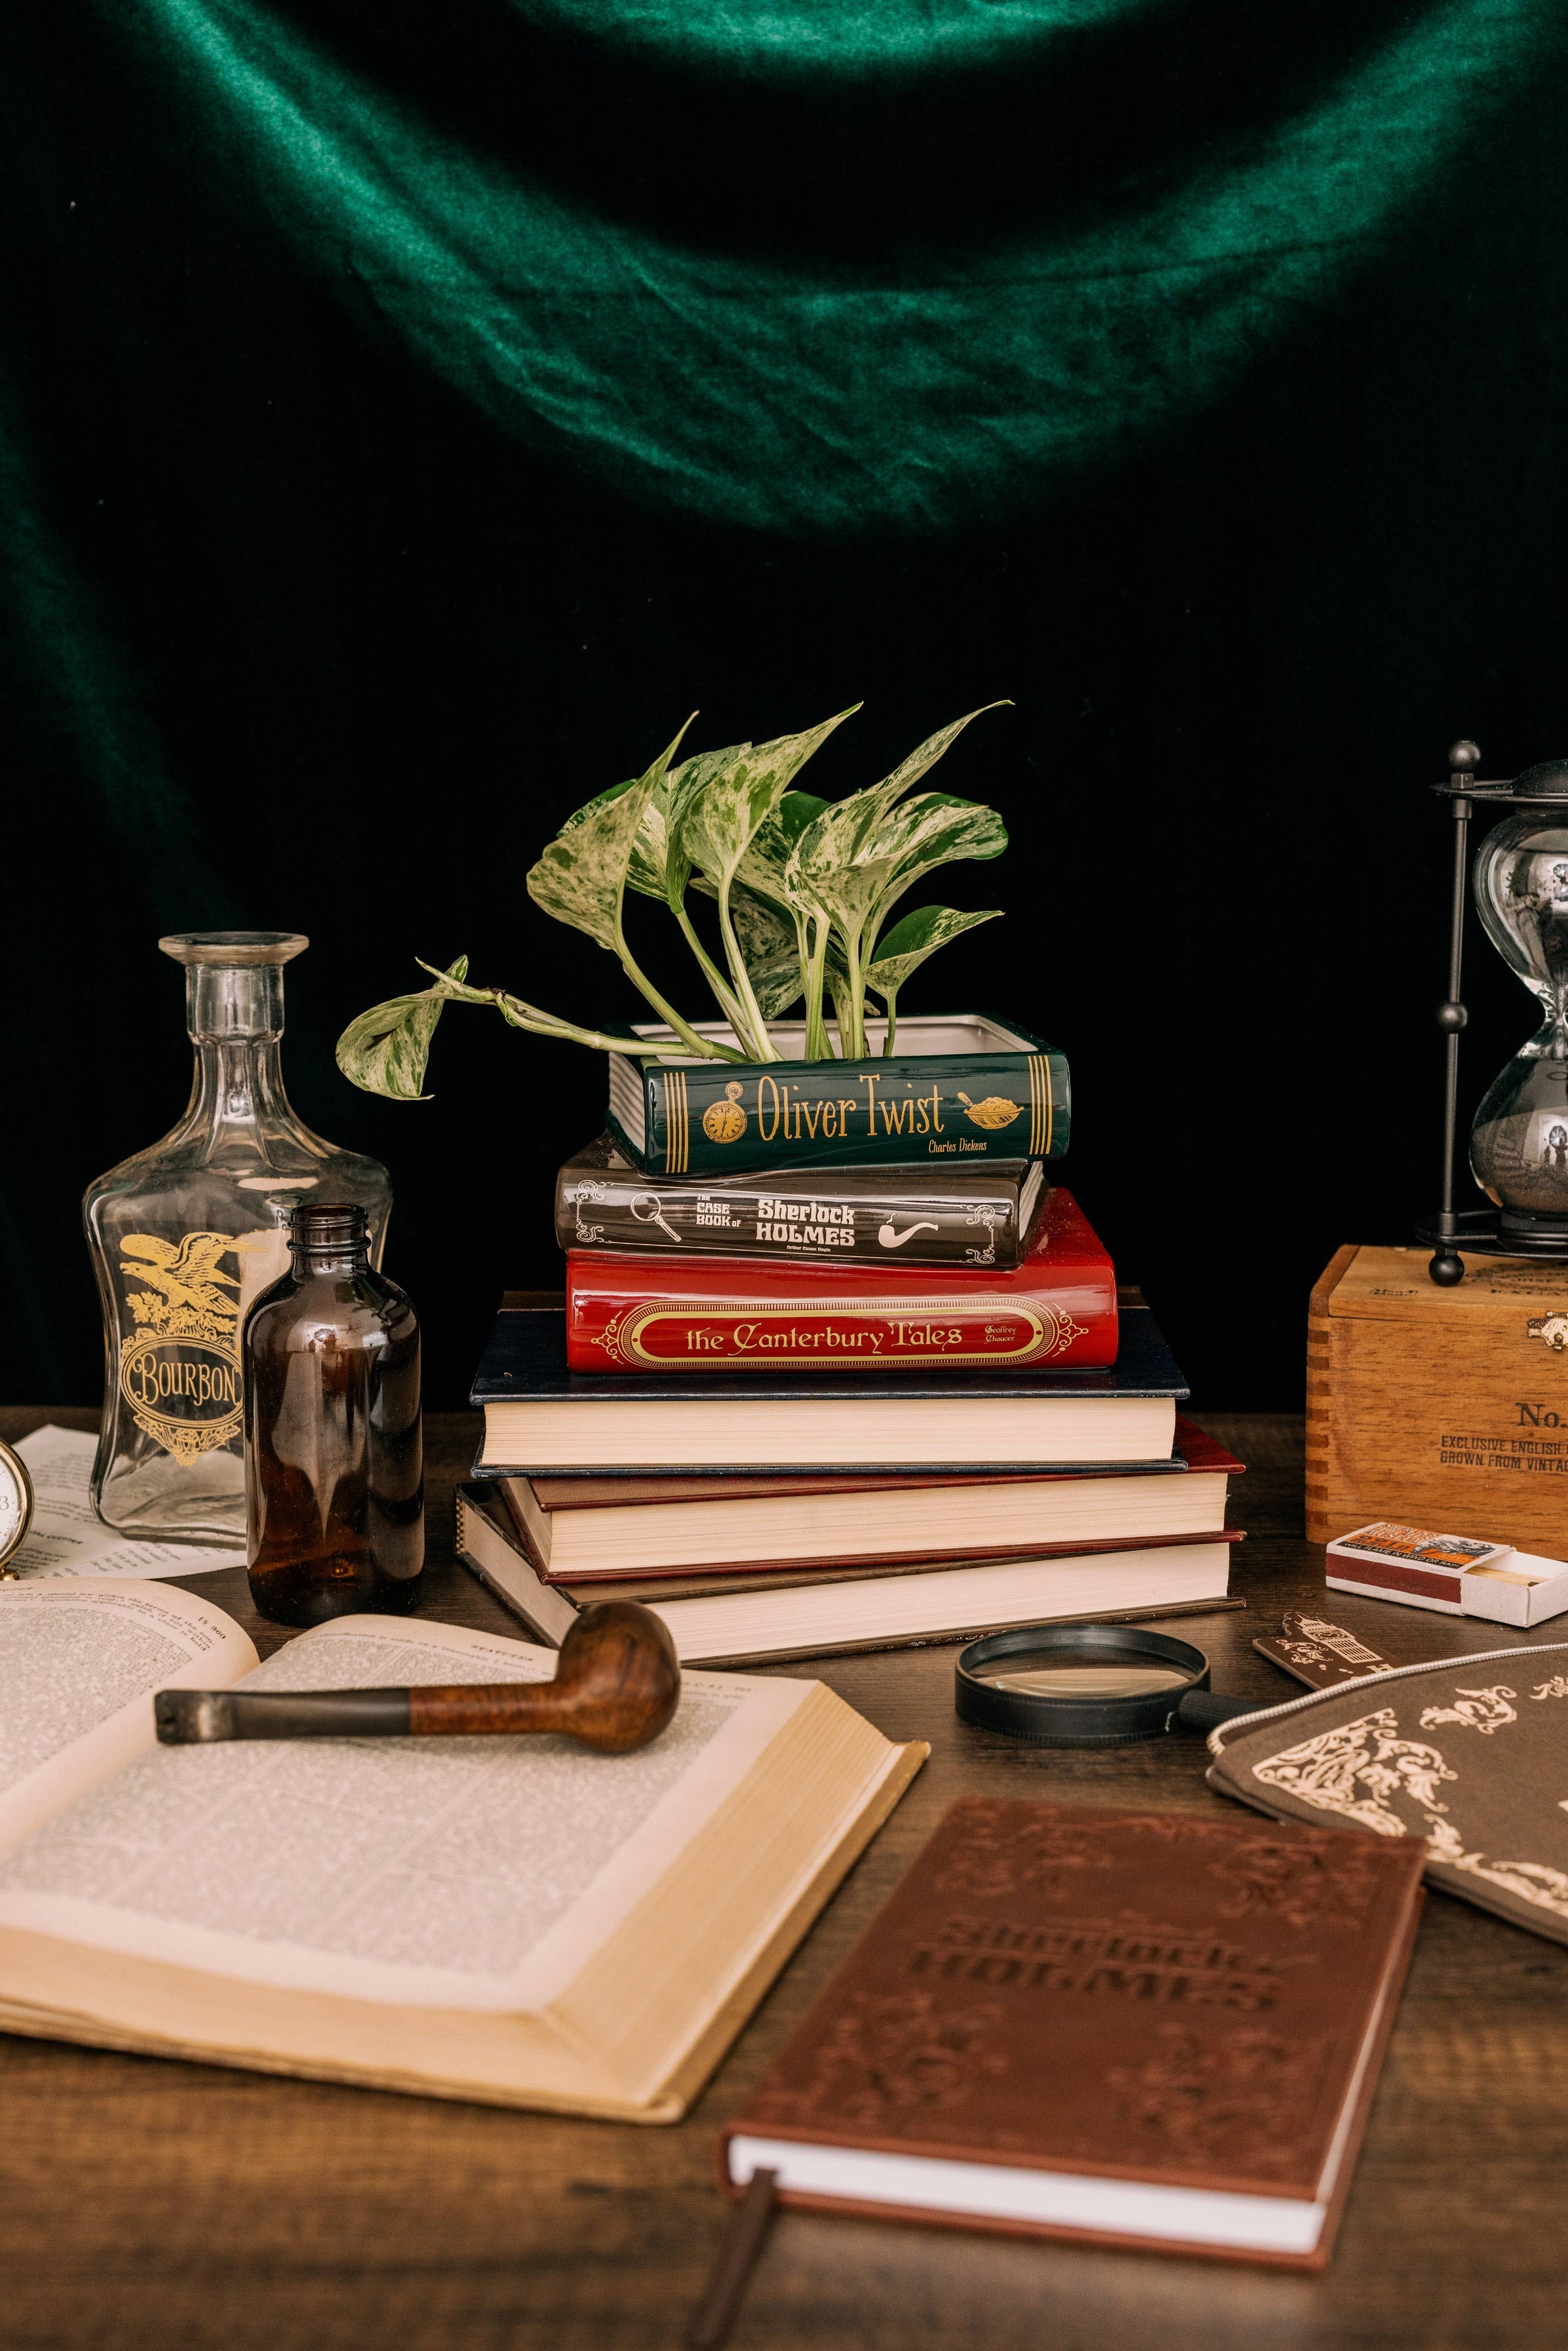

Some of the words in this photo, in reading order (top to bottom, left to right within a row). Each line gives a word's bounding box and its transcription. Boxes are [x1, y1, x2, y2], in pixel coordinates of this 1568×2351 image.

[758, 1076, 857, 1142] Oliver
[859, 1074, 944, 1136] Twist
[928, 1139, 956, 1153] Charles
[958, 1138, 987, 1152] Dickens
[696, 1202, 730, 1215] CASE
[757, 1199, 855, 1226] Sherlock
[696, 1214, 731, 1227] BOOK
[756, 1221, 855, 1247] HOLMES
[685, 1326, 725, 1351] the
[727, 1323, 885, 1356] Canterbury
[887, 1322, 963, 1352] Tales
[985, 1325, 1017, 1335] Geoffrey
[983, 1334, 1015, 1345] Chaucer
[1515, 1402, 1567, 1428] No.
[1441, 1436, 1507, 1452] EXCLUSIVE
[1511, 1440, 1560, 1455] ENGLISH
[1439, 1451, 1484, 1466] GROWN
[1488, 1455, 1521, 1469] FROM
[1364, 1546, 1391, 1554] FLAME
